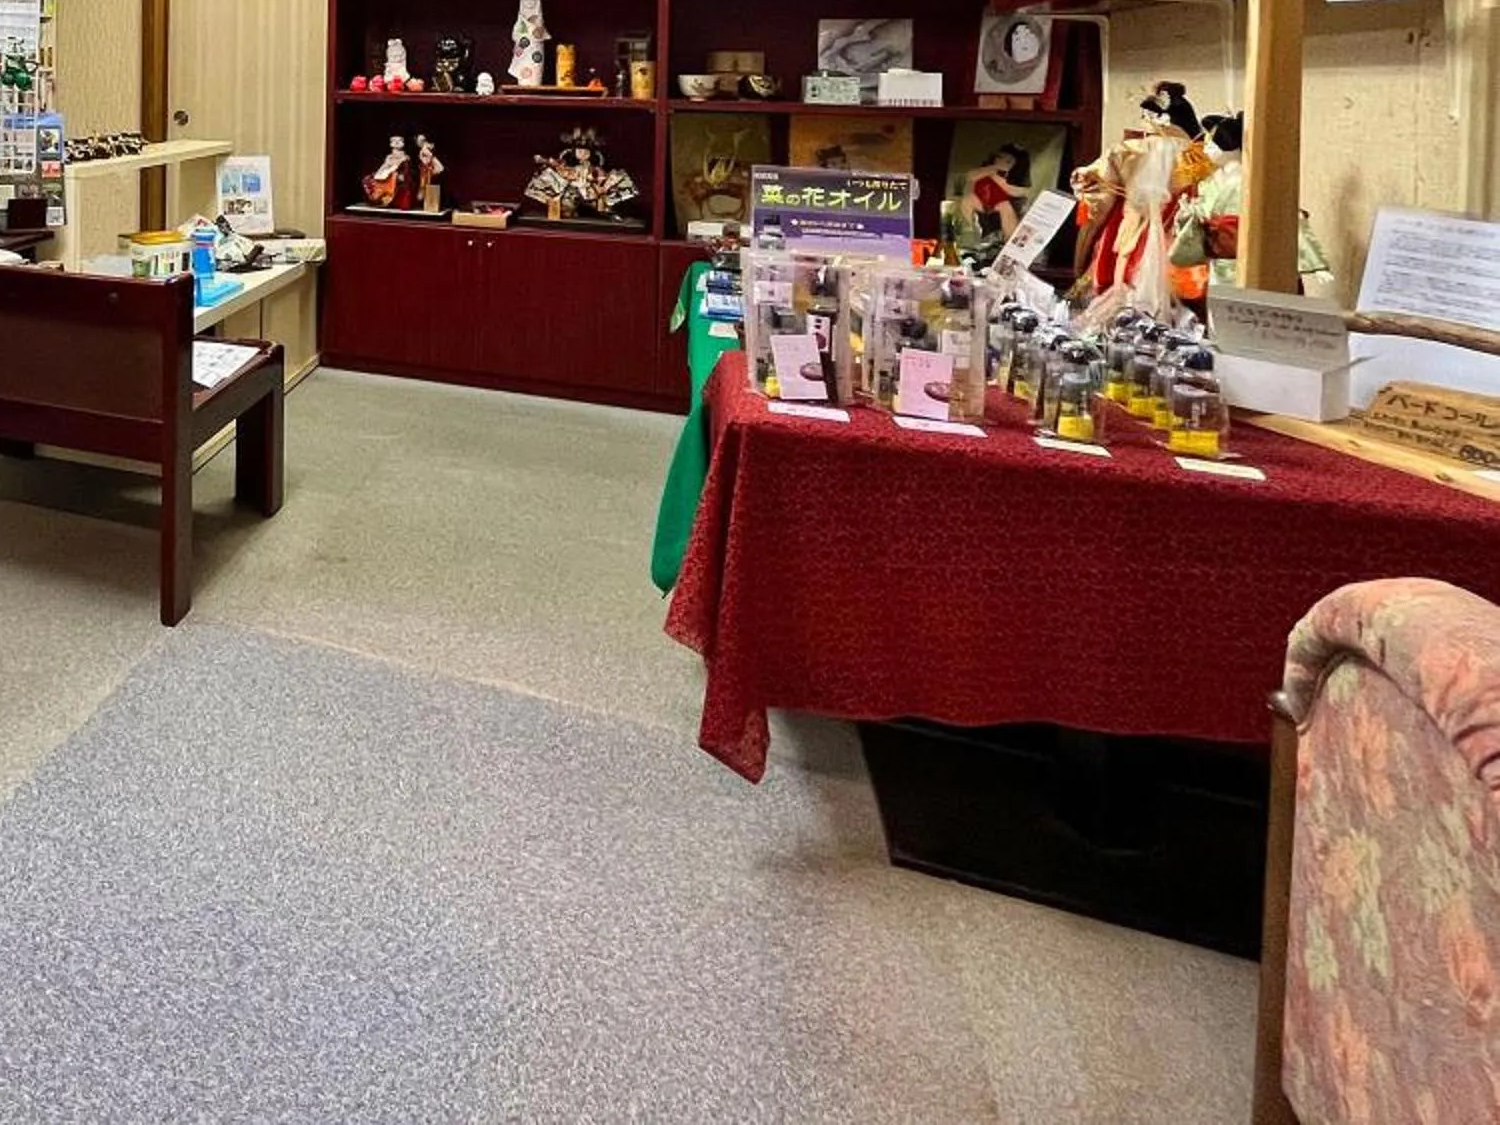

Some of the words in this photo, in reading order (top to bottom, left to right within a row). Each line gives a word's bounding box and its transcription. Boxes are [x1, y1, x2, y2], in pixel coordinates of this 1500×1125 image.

[761, 184, 903, 212] 菜の花オイル
